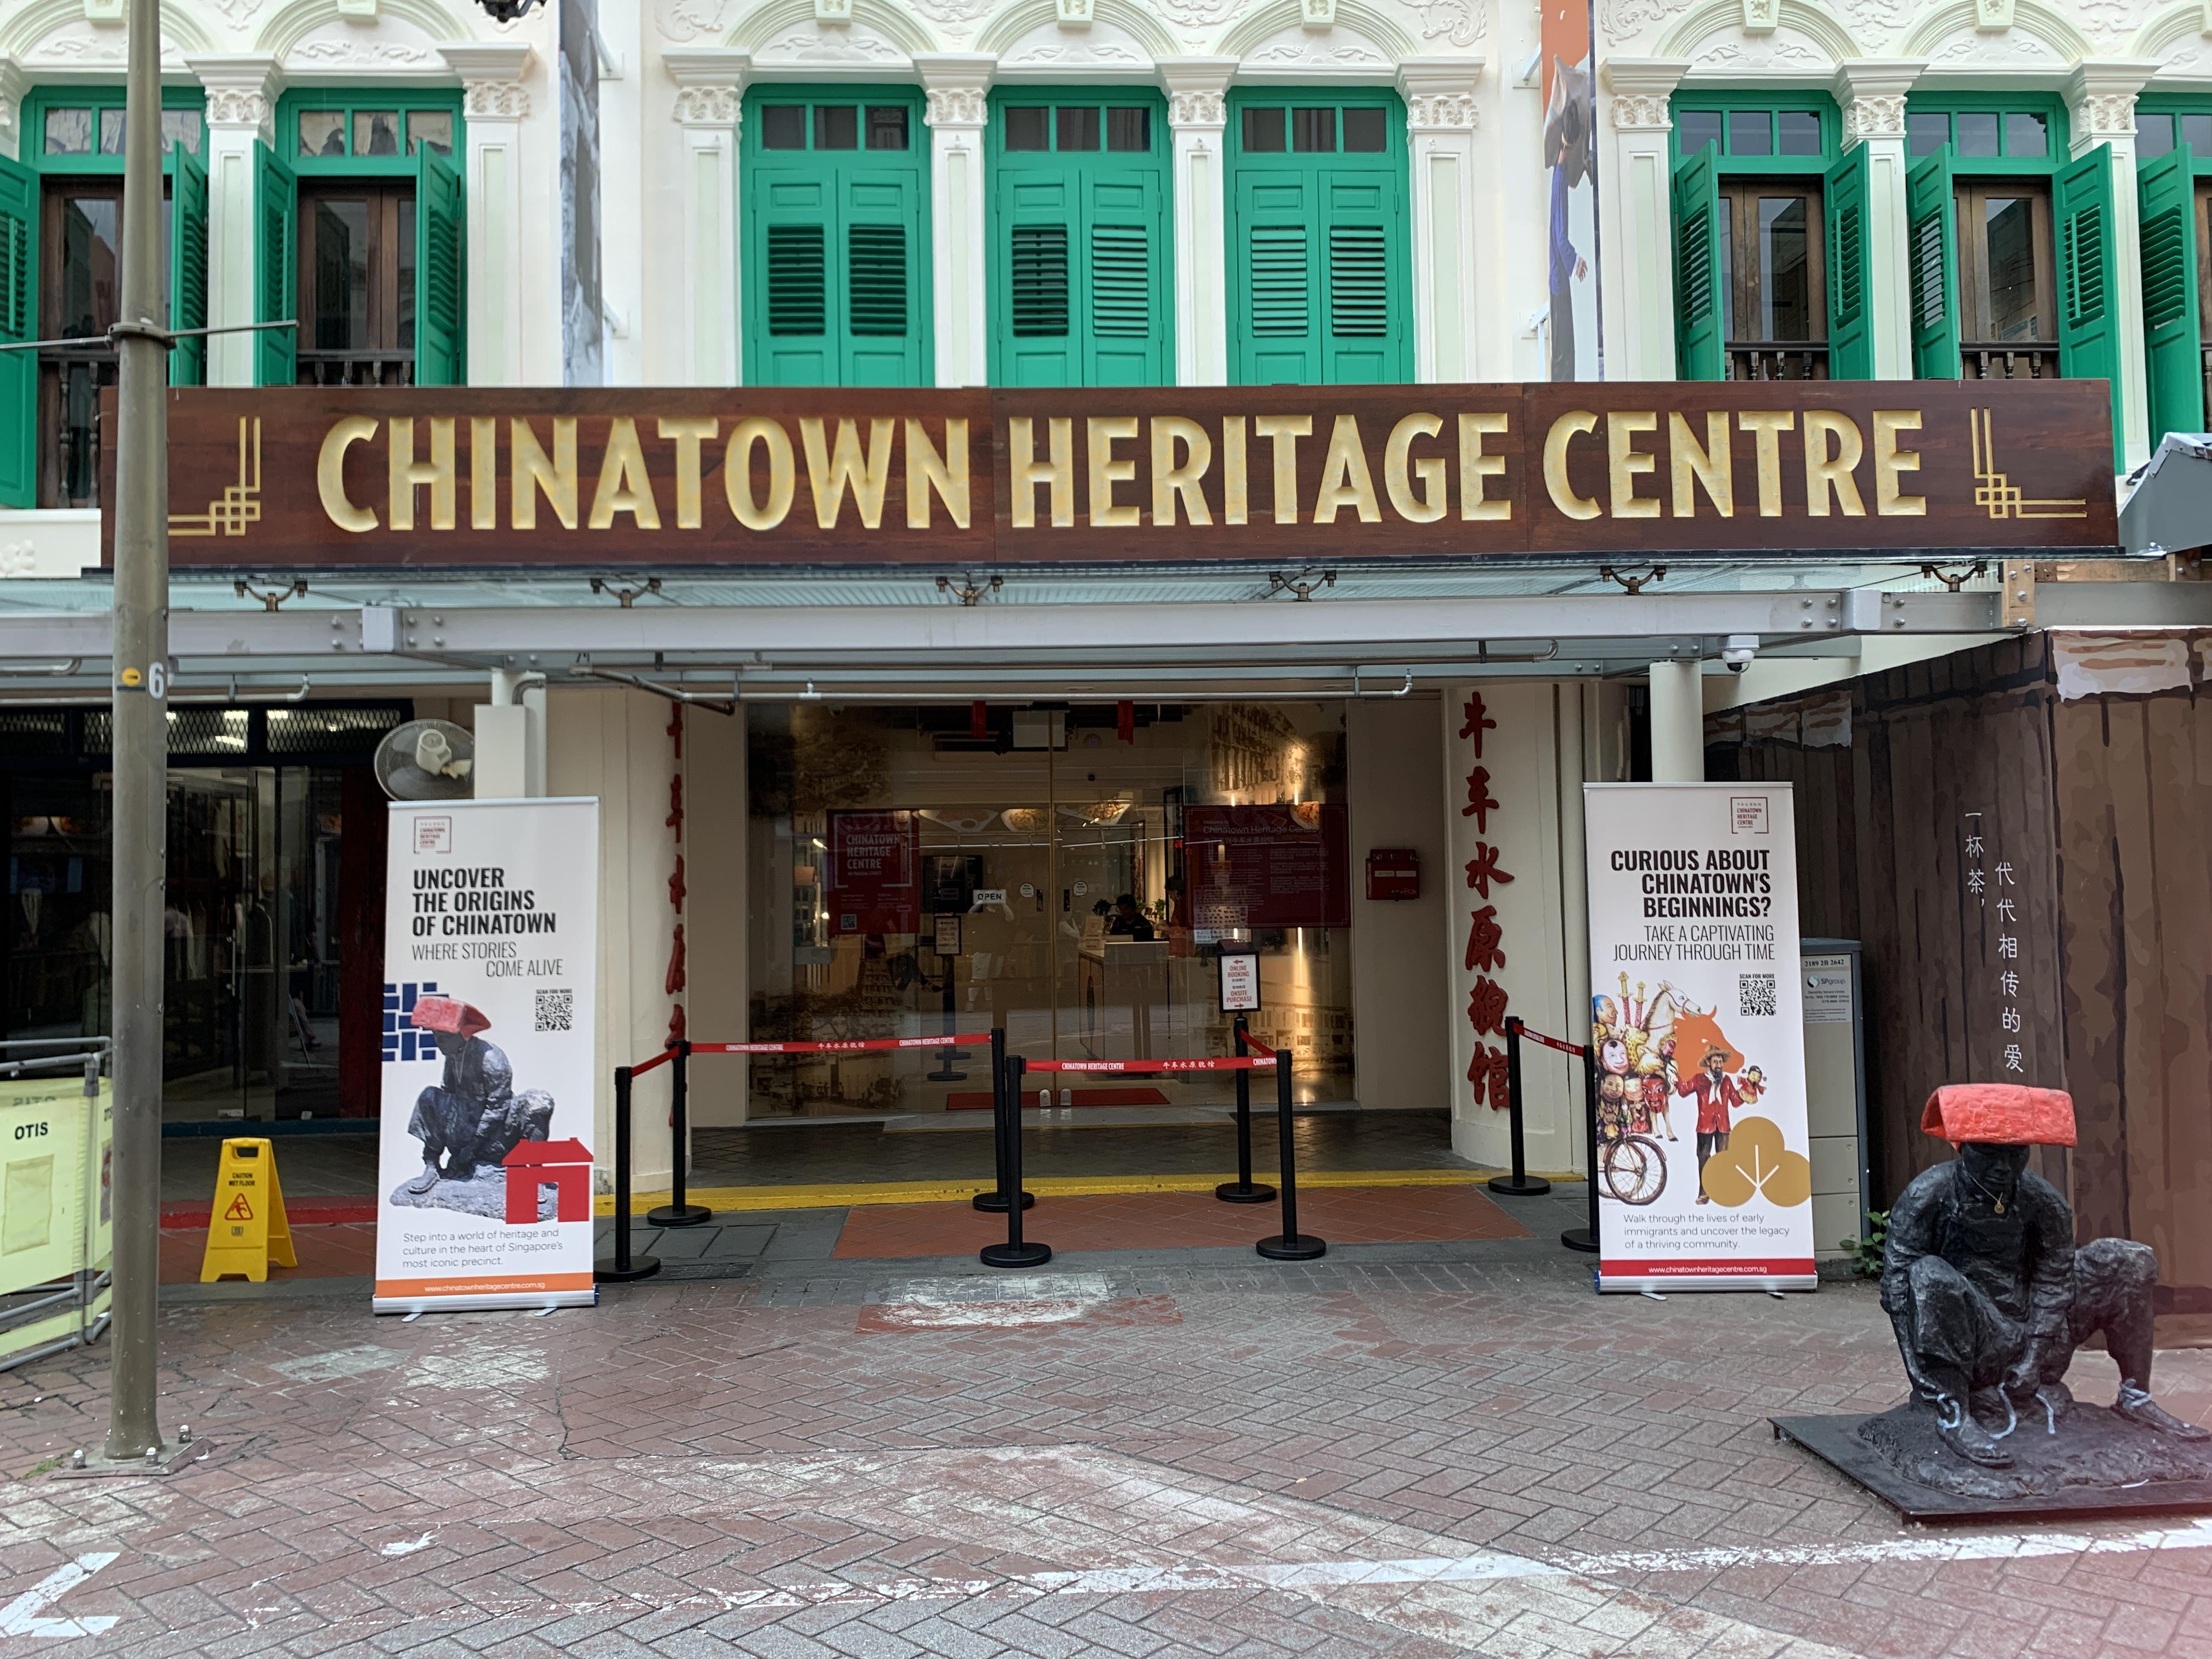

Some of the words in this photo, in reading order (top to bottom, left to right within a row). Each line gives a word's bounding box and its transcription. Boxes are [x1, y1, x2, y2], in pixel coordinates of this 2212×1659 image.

[317, 415, 971, 532] CHINATOWN
[1009, 413, 1511, 528] HERITAGE
[1543, 409, 1927, 520] CENTRE
[149, 662, 164, 699] 6
[1203, 825, 1249, 834] Chinatown
[1251, 825, 1287, 834] Heritage
[846, 834, 901, 845] CHINATOWN
[847, 847, 891, 857] HERITAGE
[1611, 850, 1700, 871] CURIOUS
[1706, 849, 1770, 870] ABOUT
[847, 859, 882, 869] CENTRE
[414, 867, 505, 889] UNCOVER
[1641, 873, 1771, 894] CHINATOWN'S
[413, 891, 448, 913] THE
[454, 890, 535, 911] ORIGINS
[1643, 896, 1771, 917] BEGINNINGS?
[413, 915, 437, 936] OF
[442, 912, 556, 935] CHINATOWN
[1644, 925, 1675, 942] TAKE
[1679, 925, 1688, 941] A
[1691, 925, 1775, 941] CAPTIVATING
[412, 942, 459, 960] WHERE
[461, 941, 517, 959] STORIES
[1613, 944, 1672, 961] JOURNEY
[1676, 944, 1741, 960] THROUGH
[1745, 944, 1775, 960] TIME
[486, 960, 524, 978] COME
[527, 958, 563, 976] ALIVE
[1995, 861, 2024, 1073] 代代相传的爱
[15, 1121, 48, 1140] OTIS
[1623, 1214, 1646, 1223] Walk
[1649, 1214, 1686, 1225] through
[1689, 1214, 1704, 1222] the
[1707, 1214, 1727, 1222] lives
[1729, 1214, 1740, 1222] of
[1742, 1214, 1764, 1224] early
[403, 1233, 426, 1243] Step
[429, 1232, 447, 1242] into
[458, 1231, 484, 1240] world
[487, 1230, 498, 1239] of
[500, 1229, 538, 1239] heritage
[541, 1228, 559, 1237] and
[1624, 1227, 1678, 1238] immigrants
[1680, 1227, 1698, 1235] and
[1741, 1227, 1756, 1235] the
[1759, 1226, 1790, 1237] legacy
[403, 1245, 437, 1256] culture
[439, 1245, 447, 1254] in
[449, 1244, 466, 1254] the
[468, 1243, 493, 1253] heart
[495, 1243, 506, 1252] of
[1624, 1240, 1635, 1249] of
[1646, 1239, 1680, 1250] thriving
[1683, 1240, 1740, 1250] community.
[403, 1259, 427, 1268] most
[430, 1257, 459, 1267] iconic
[461, 1256, 503, 1267] precinct.
[1648, 1266, 1768, 1274] www.chinatownheritagecentre.com.sg
[424, 1282, 546, 1293] www.chinatownheritagecentre.com.sg
